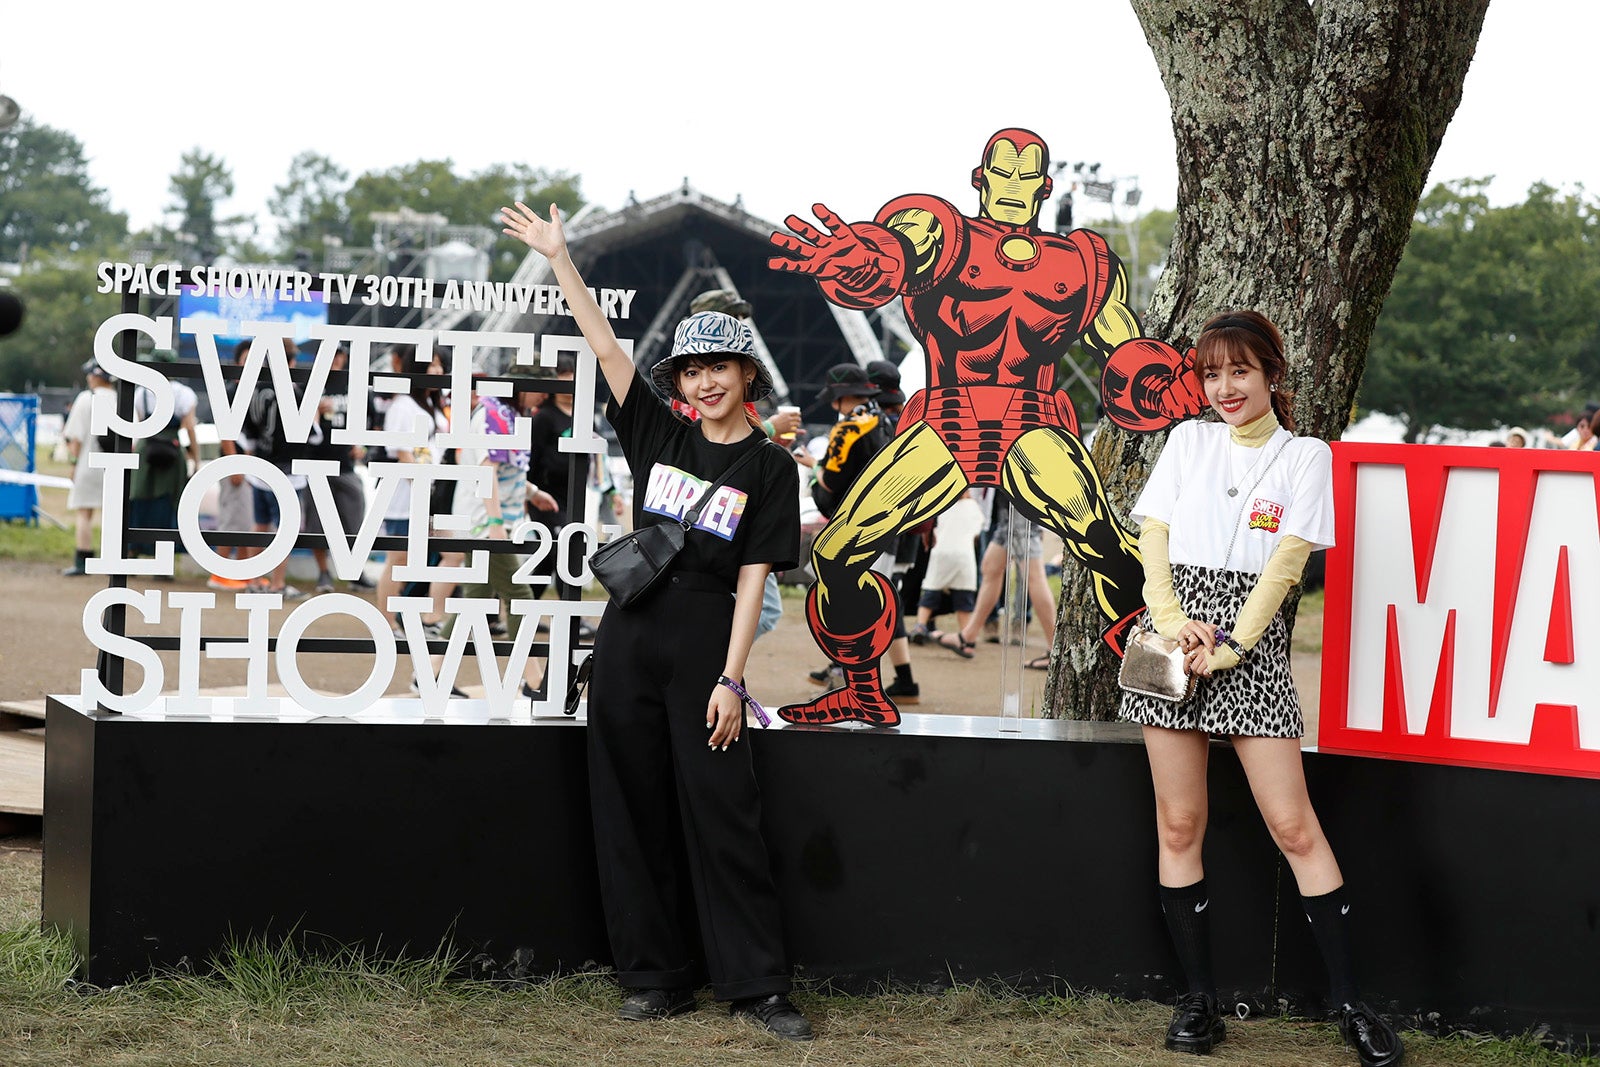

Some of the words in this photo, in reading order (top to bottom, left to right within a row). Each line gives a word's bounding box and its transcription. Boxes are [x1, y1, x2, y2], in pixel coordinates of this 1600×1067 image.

[97, 262, 182, 296] SPACE
[190, 265, 313, 303] SHOWER
[319, 273, 358, 305] TV
[361, 275, 434, 309] 30TH
[441, 279, 636, 319] ANNIVERRY
[89, 313, 634, 454] SWEET
[85, 454, 494, 583] LOVE
[1249, 520, 1279, 529] SHOWER
[1253, 498, 1284, 518] SWEET
[1255, 512, 1273, 522] LOVE
